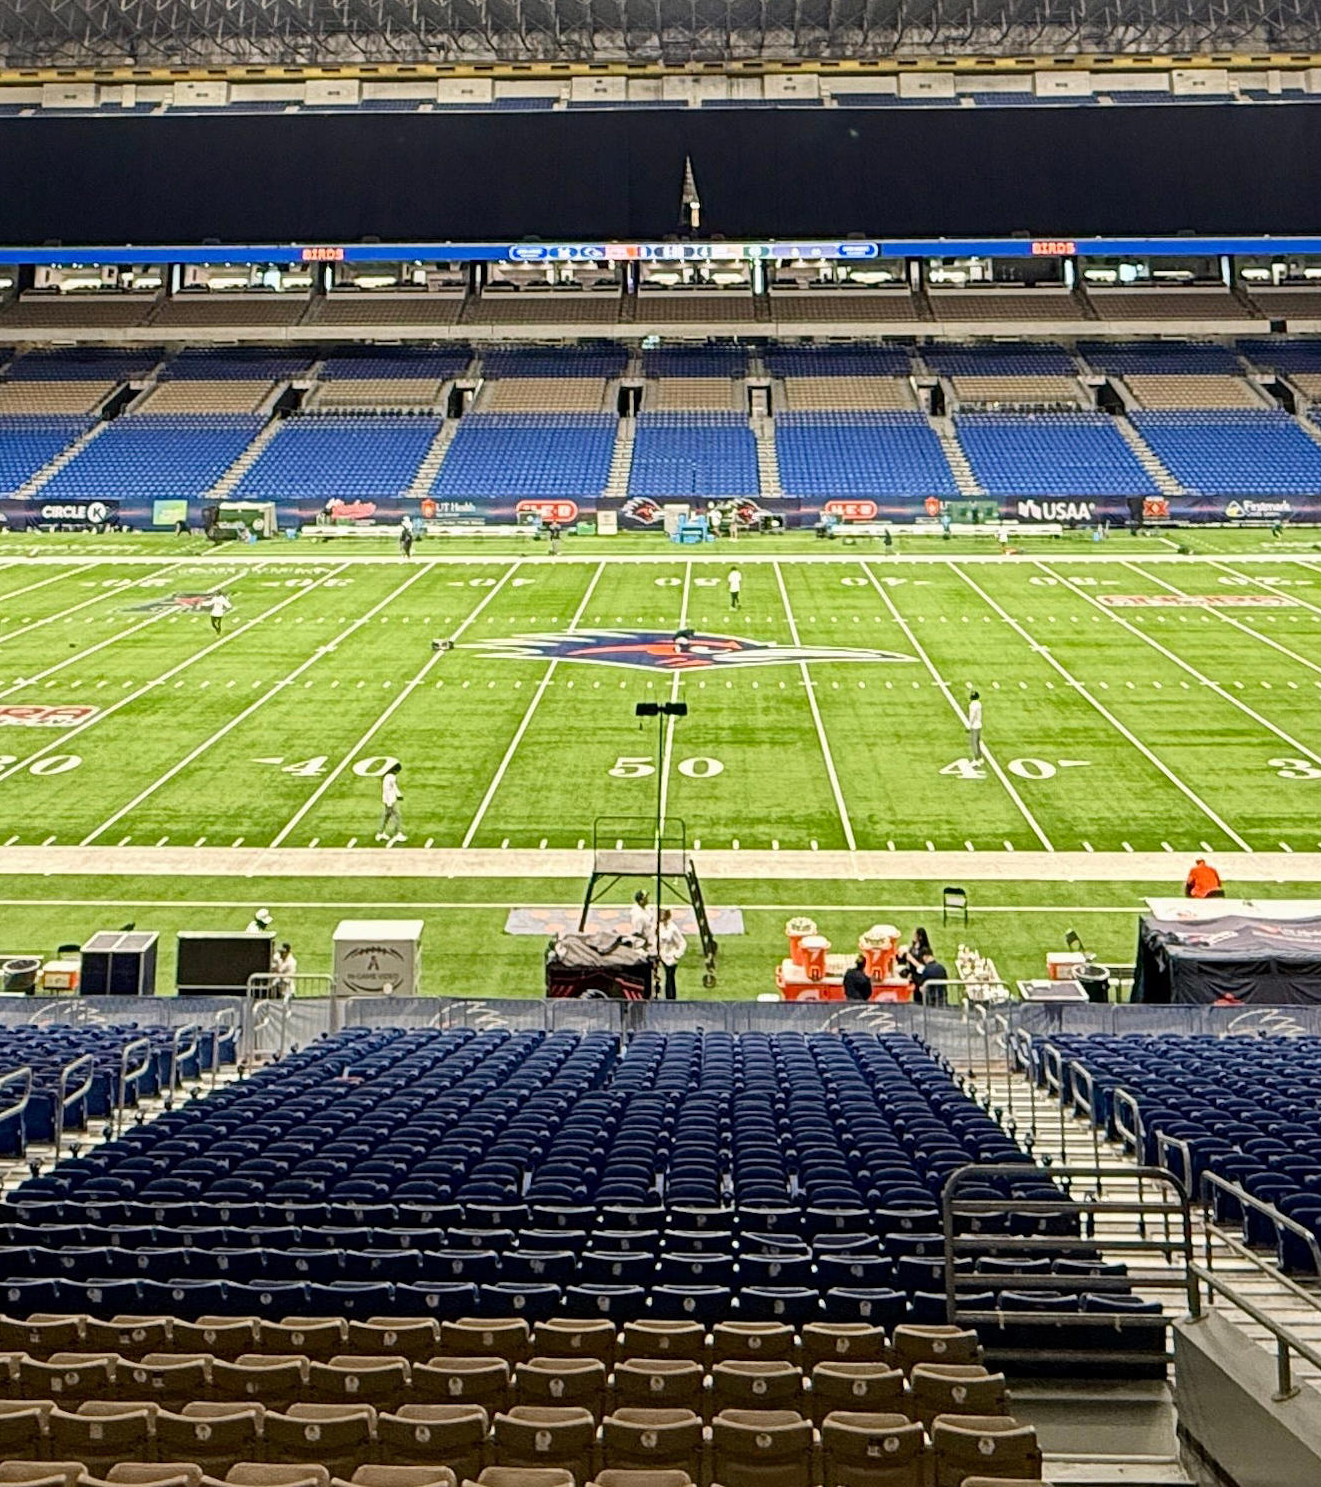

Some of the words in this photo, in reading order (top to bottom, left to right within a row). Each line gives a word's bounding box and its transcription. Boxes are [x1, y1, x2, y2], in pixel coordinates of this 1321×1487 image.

[303, 248, 344, 261] BIRDS
[1031, 242, 1075, 255] BIRDS
[41, 505, 86, 519] CIRCLE
[1042, 502, 1091, 520] USAA
[608, 756, 724, 778] 50
